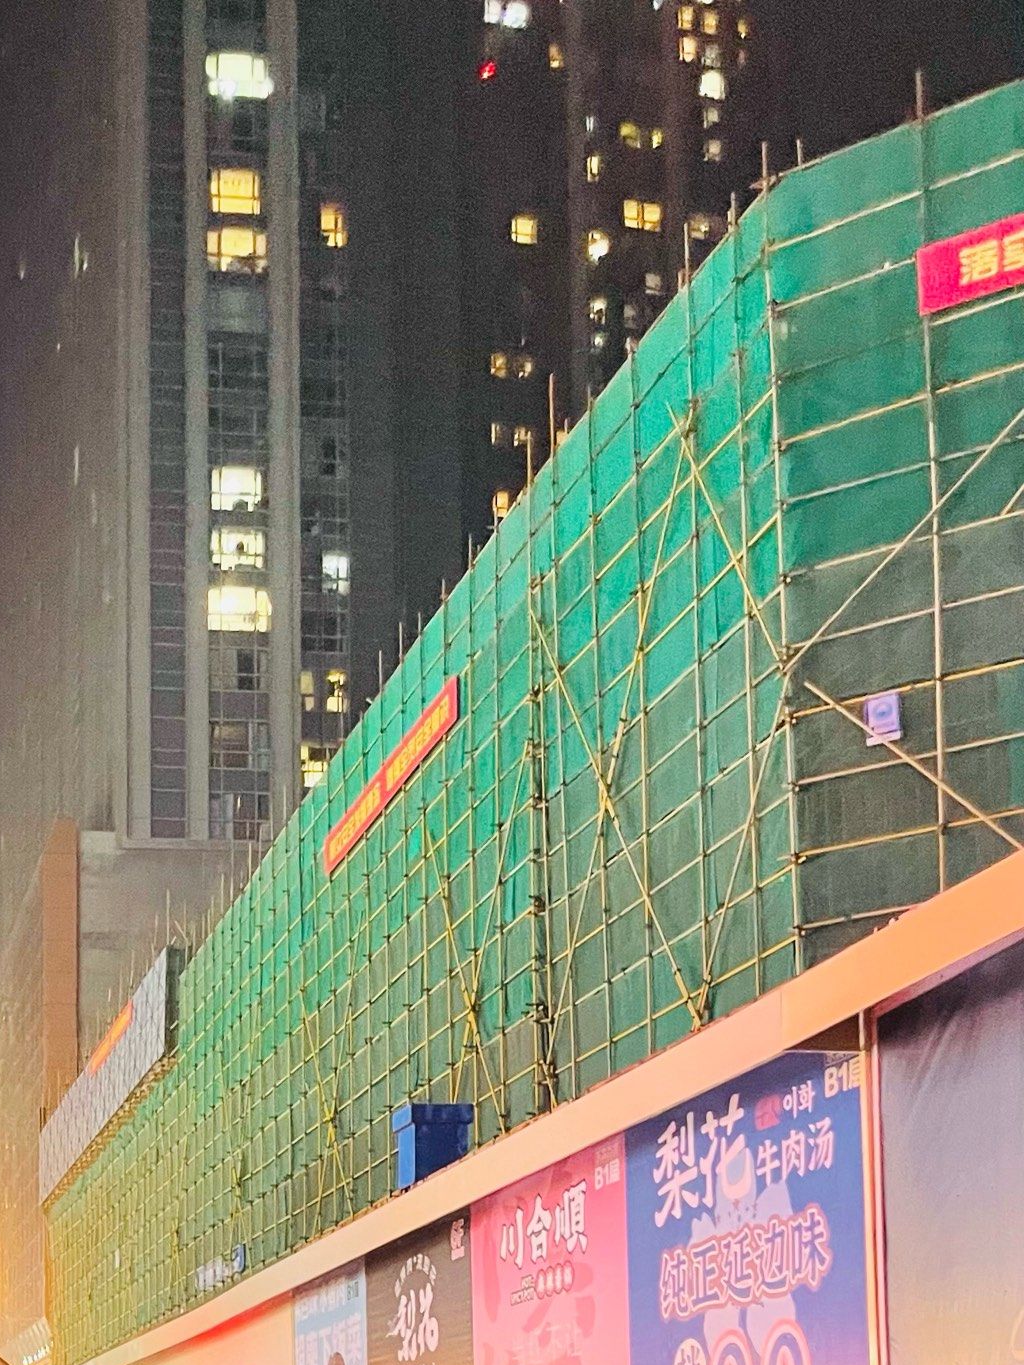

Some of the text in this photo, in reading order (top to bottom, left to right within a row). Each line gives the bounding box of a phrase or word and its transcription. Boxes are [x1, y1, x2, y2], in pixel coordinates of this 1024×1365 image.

[782, 1080, 816, 1118] 이화
[653, 1093, 749, 1228] 梨花
[756, 1116, 835, 1188] 牛肉汤
[661, 1206, 830, 1319] 纯正延边味
